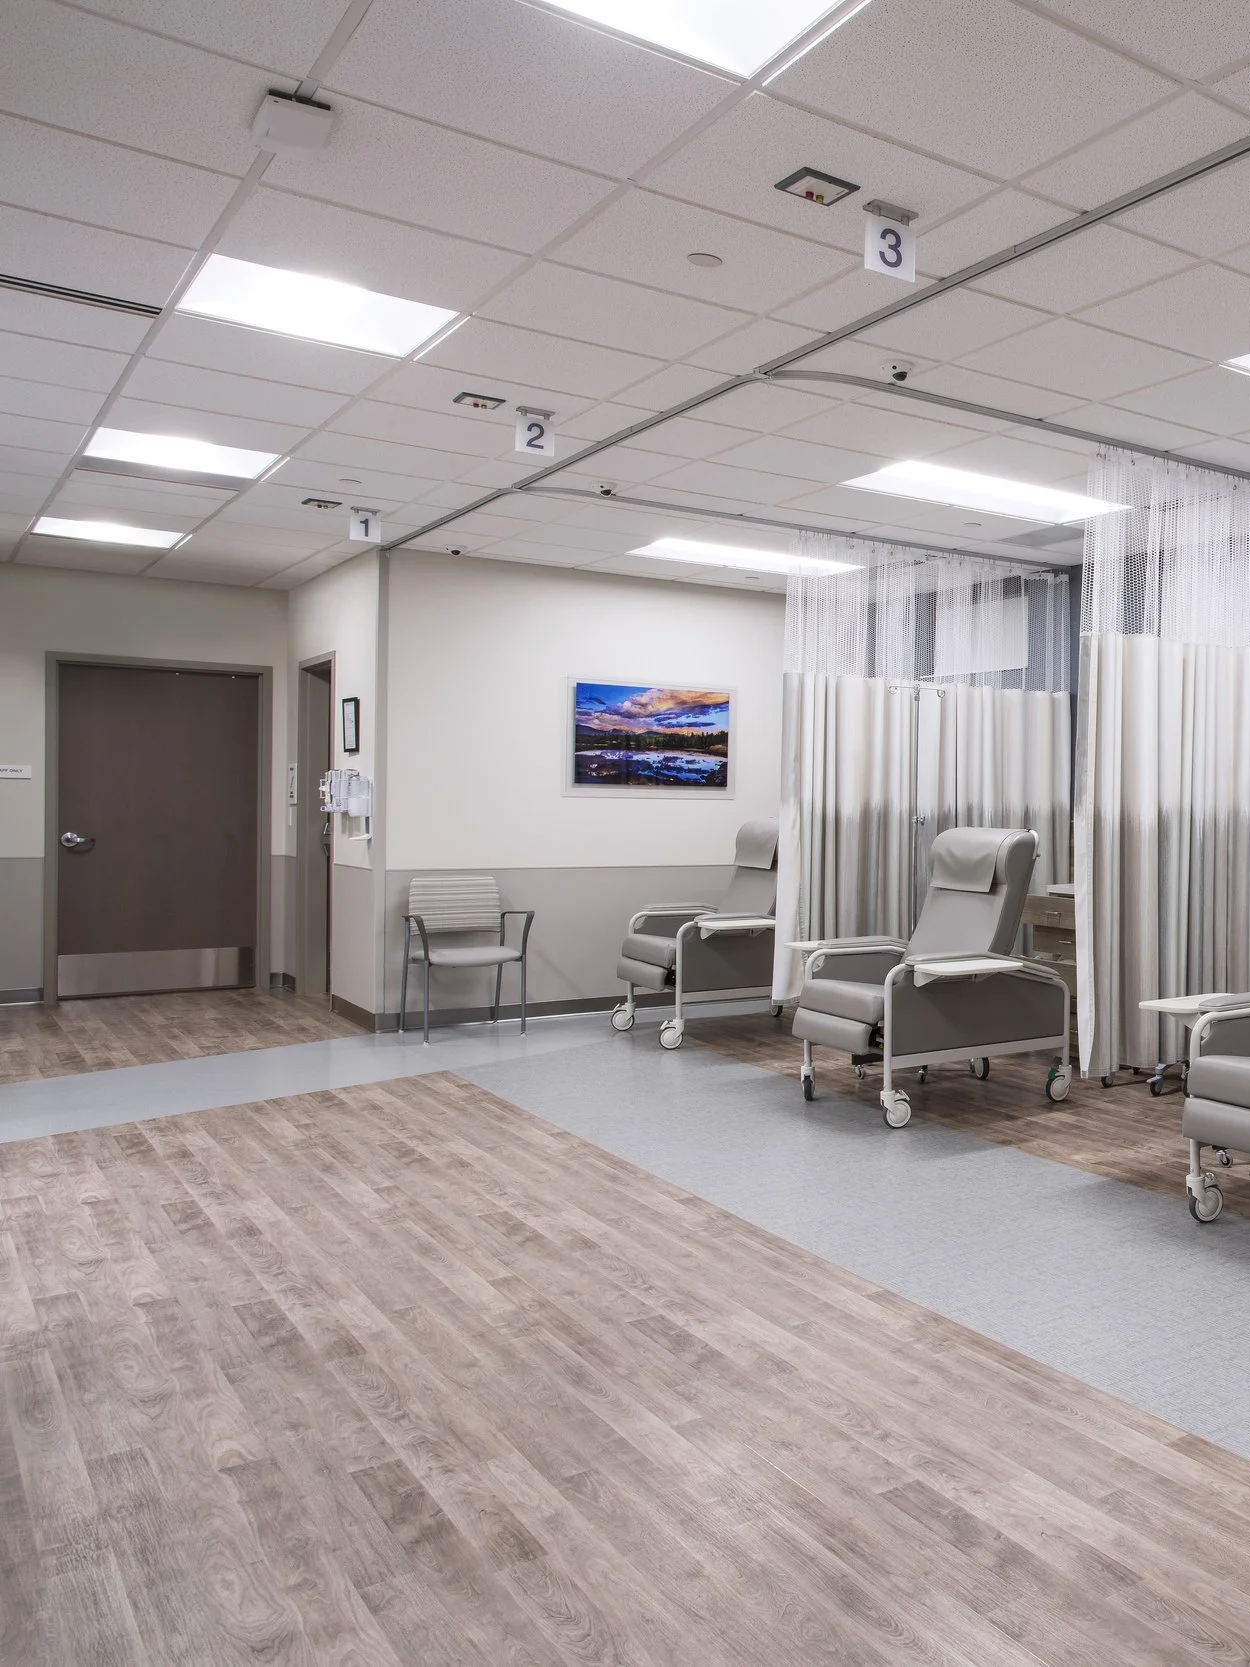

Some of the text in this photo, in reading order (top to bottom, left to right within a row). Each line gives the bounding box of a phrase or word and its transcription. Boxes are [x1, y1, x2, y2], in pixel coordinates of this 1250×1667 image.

[879, 228, 902, 268] 3
[526, 423, 544, 449] 2
[360, 518, 368, 537] 1
